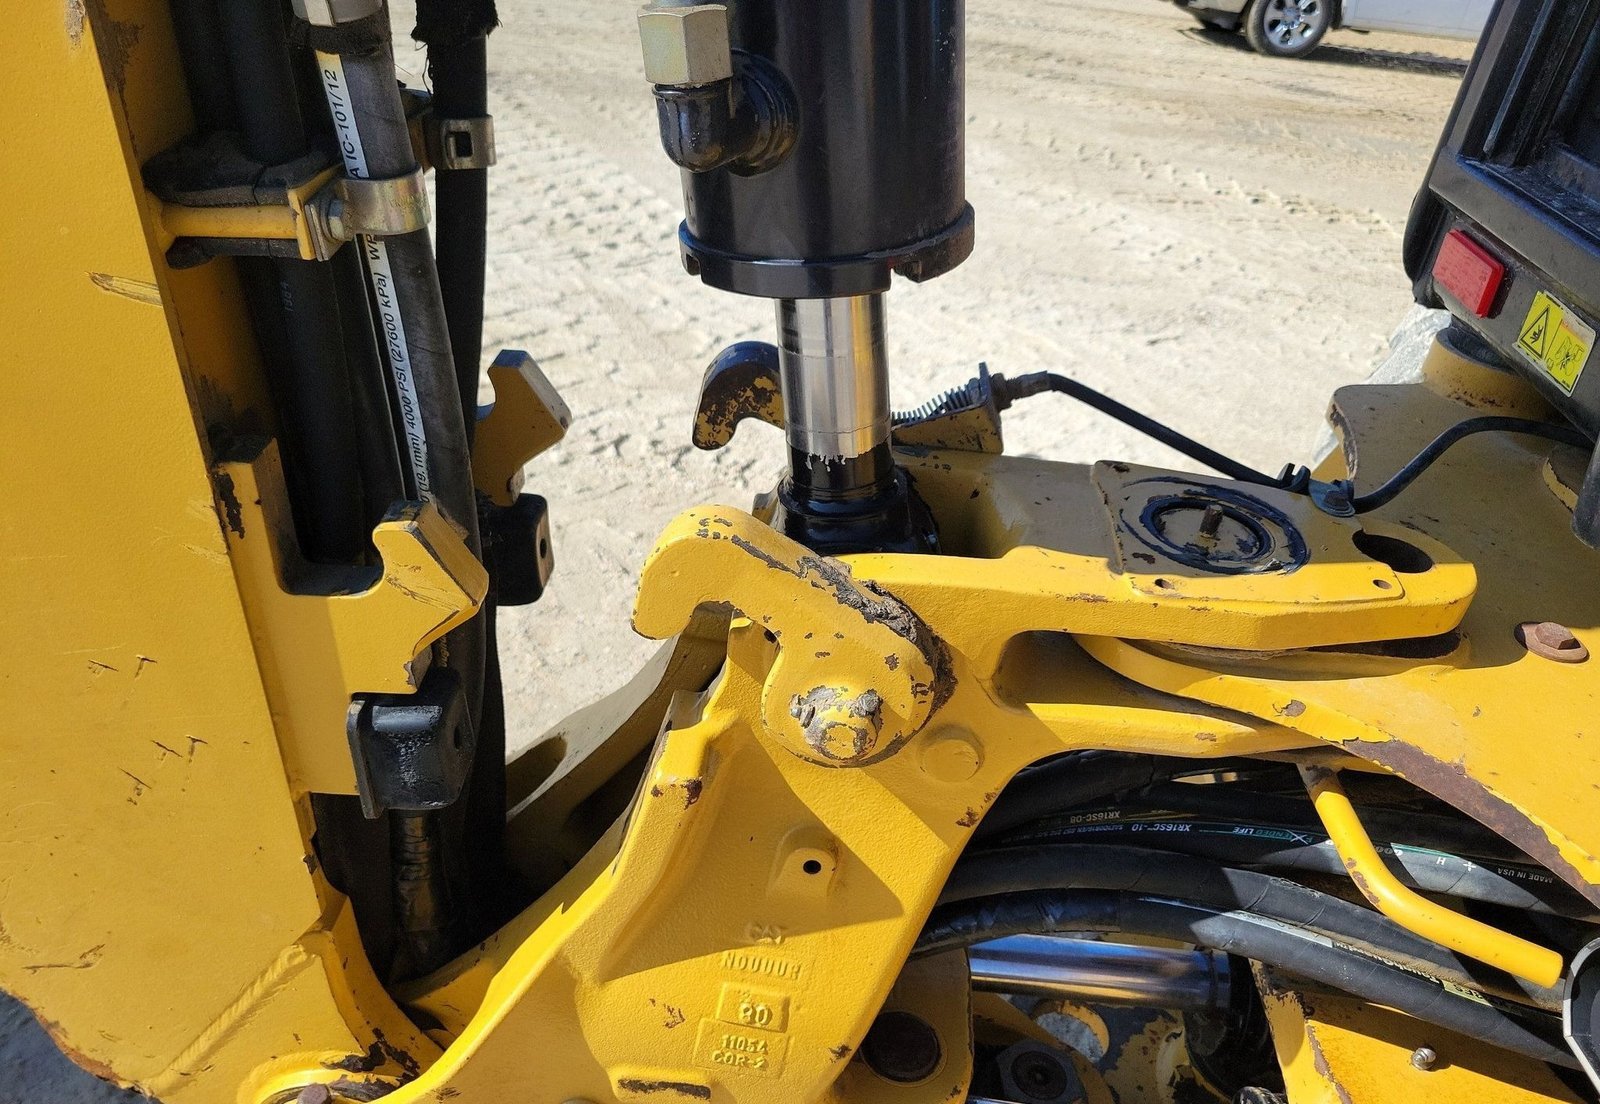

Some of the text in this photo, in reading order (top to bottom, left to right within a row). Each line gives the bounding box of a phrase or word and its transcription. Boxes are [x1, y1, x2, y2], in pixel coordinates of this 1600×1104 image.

[324, 69, 356, 161] IC-101/12
[376, 272, 394, 309] kPa)
[384, 312, 404, 364] (27600
[397, 366, 410, 392] PSI
[402, 395, 417, 429] 4000
[1070, 810, 1121, 824] XR16SC-08
[1231, 826, 1255, 836] LIFE
[1496, 867, 1554, 884] MADE IN USA
